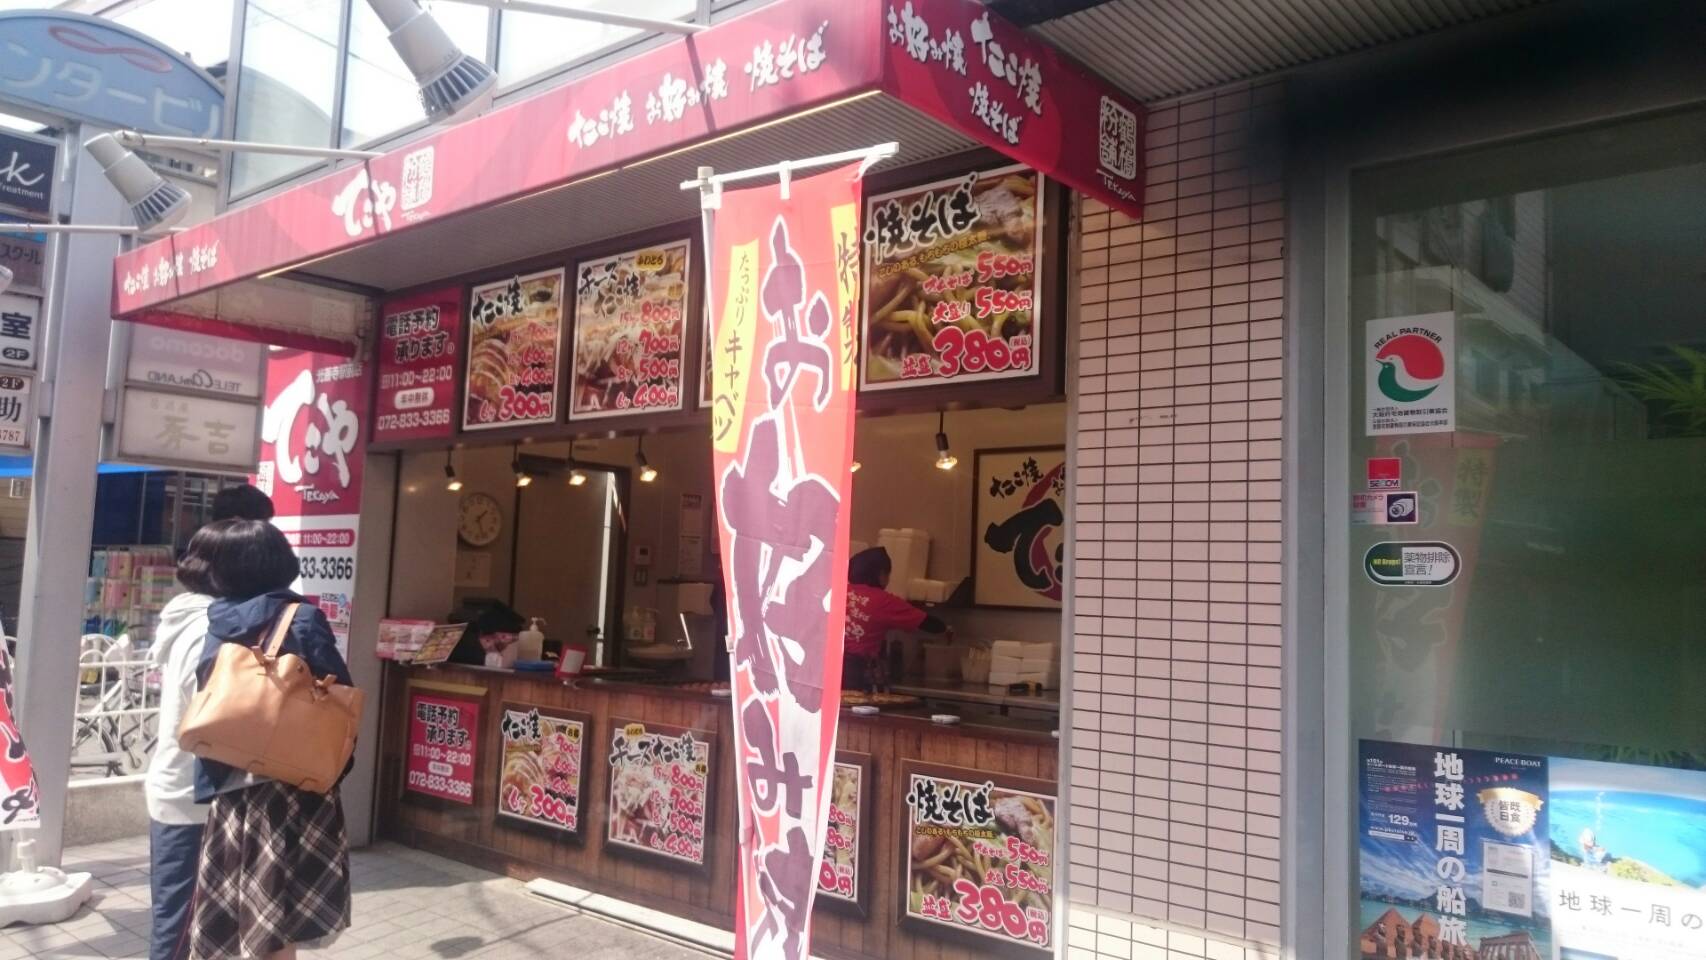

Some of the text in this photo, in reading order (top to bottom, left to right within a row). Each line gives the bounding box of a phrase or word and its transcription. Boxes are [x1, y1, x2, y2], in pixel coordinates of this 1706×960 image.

[888, 1, 1042, 115] お好み焼 たこ焼
[2, 42, 221, 141] ンタービ
[567, 20, 829, 149] たこ焼 お好み焼 焼そば
[968, 81, 1022, 144] 焼そば
[331, 167, 397, 237] てこや
[864, 172, 980, 264] 焼そば
[977, 252, 1033, 282] 550円
[975, 287, 1032, 318] 550円
[1, 312, 32, 339] 室
[1374, 327, 1442, 349] REAL PARTNER
[934, 327, 1031, 377] 380円
[0, 430, 21, 442] 787
[262, 369, 358, 488] てこや
[301, 556, 352, 580] 33-3366
[829, 805, 853, 825] 80円
[907, 781, 993, 823] 焼そば
[1388, 813, 1409, 826] 129
[827, 828, 852, 848] 80円
[1007, 837, 1048, 864] 550円
[1434, 752, 1467, 946] 地球一周の船旅
[819, 861, 852, 895] 0円
[1006, 865, 1048, 893] 550円
[955, 880, 1048, 944] 380円
[1559, 889, 1704, 930] 地球一周の
